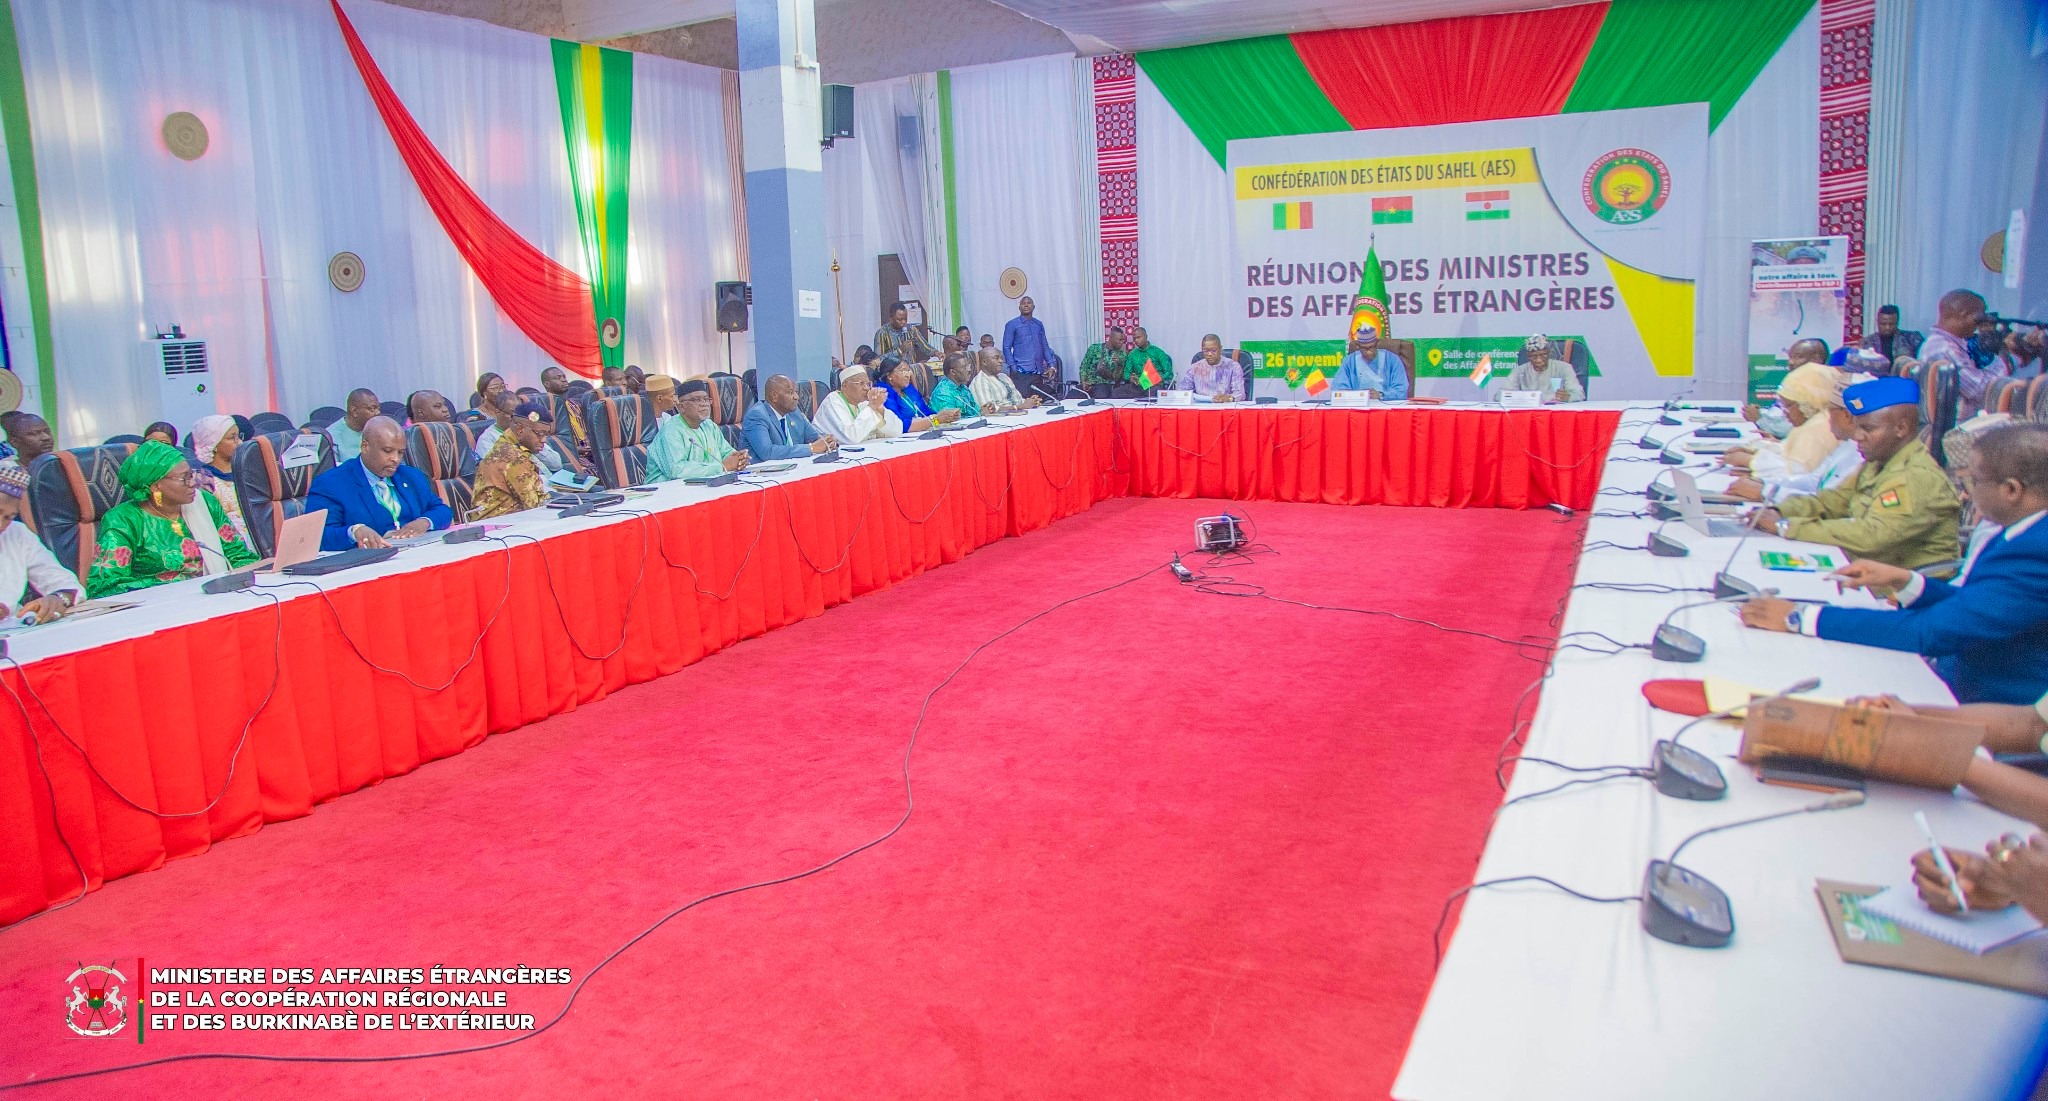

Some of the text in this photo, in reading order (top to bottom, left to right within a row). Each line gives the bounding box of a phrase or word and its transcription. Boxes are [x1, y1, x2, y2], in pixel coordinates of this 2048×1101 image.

[1251, 159, 1516, 191] CONFÉDÉRATION DES ÉTATS DU SAHEL (AES)
[1657, 162, 1667, 174] DU
[1660, 175, 1670, 199] SAHEL
[1380, 258, 1429, 282] DES
[1438, 251, 1590, 281] MINISTRES
[1248, 295, 1294, 318] DES
[1433, 280, 1616, 314] ÉTRANGÈRES
[1266, 352, 1285, 368] 26
[1443, 350, 1464, 359] Salle
[1465, 350, 1476, 359] de
[1443, 361, 1458, 370] des
